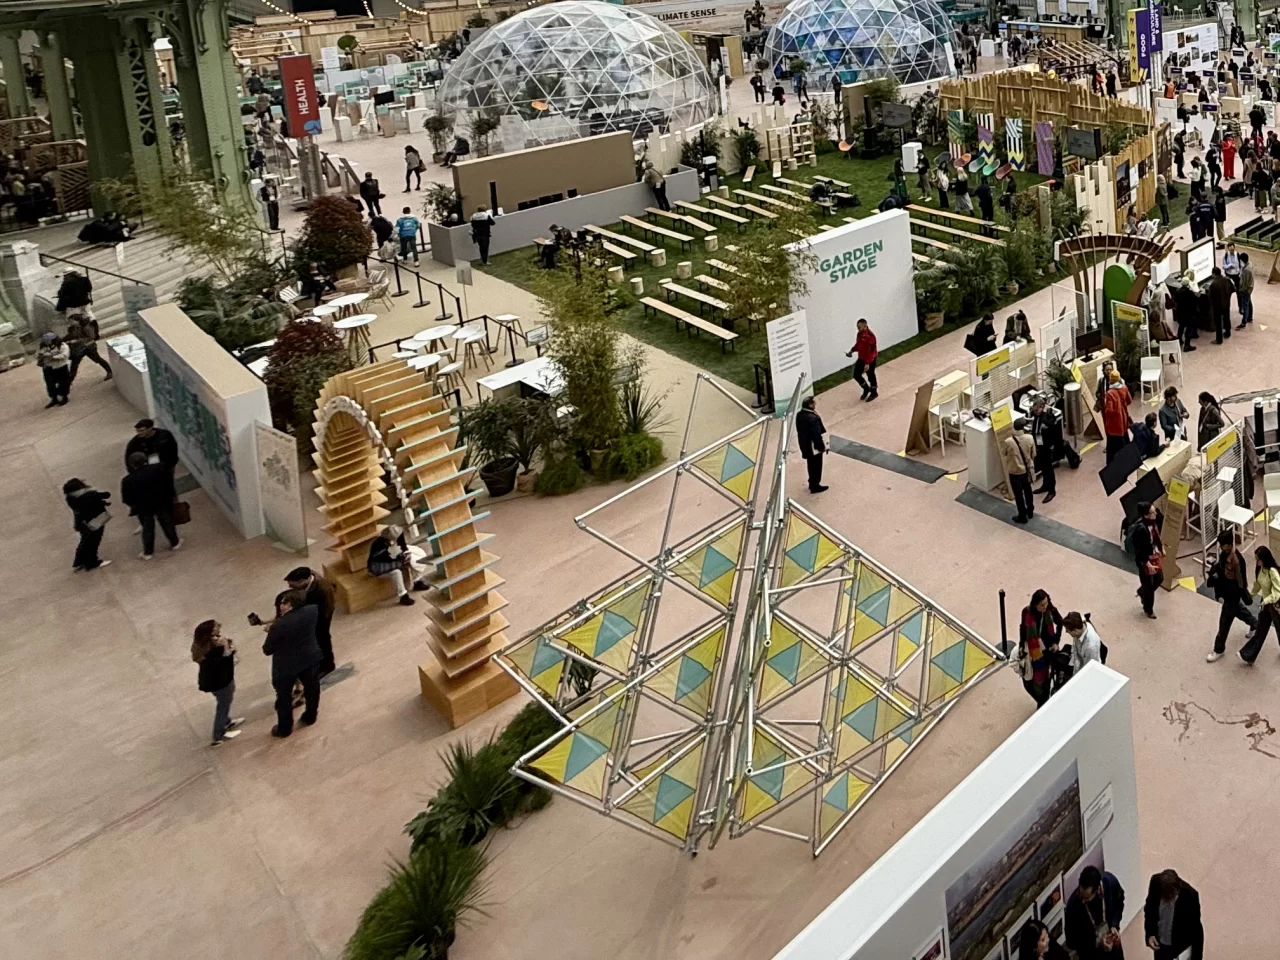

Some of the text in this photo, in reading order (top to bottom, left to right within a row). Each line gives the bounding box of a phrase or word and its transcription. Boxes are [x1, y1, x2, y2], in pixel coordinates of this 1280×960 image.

[690, 8, 717, 18] SENSE
[294, 78, 309, 115] HEALTH
[820, 239, 883, 272] GARDEN
[829, 256, 877, 283] STAGE
